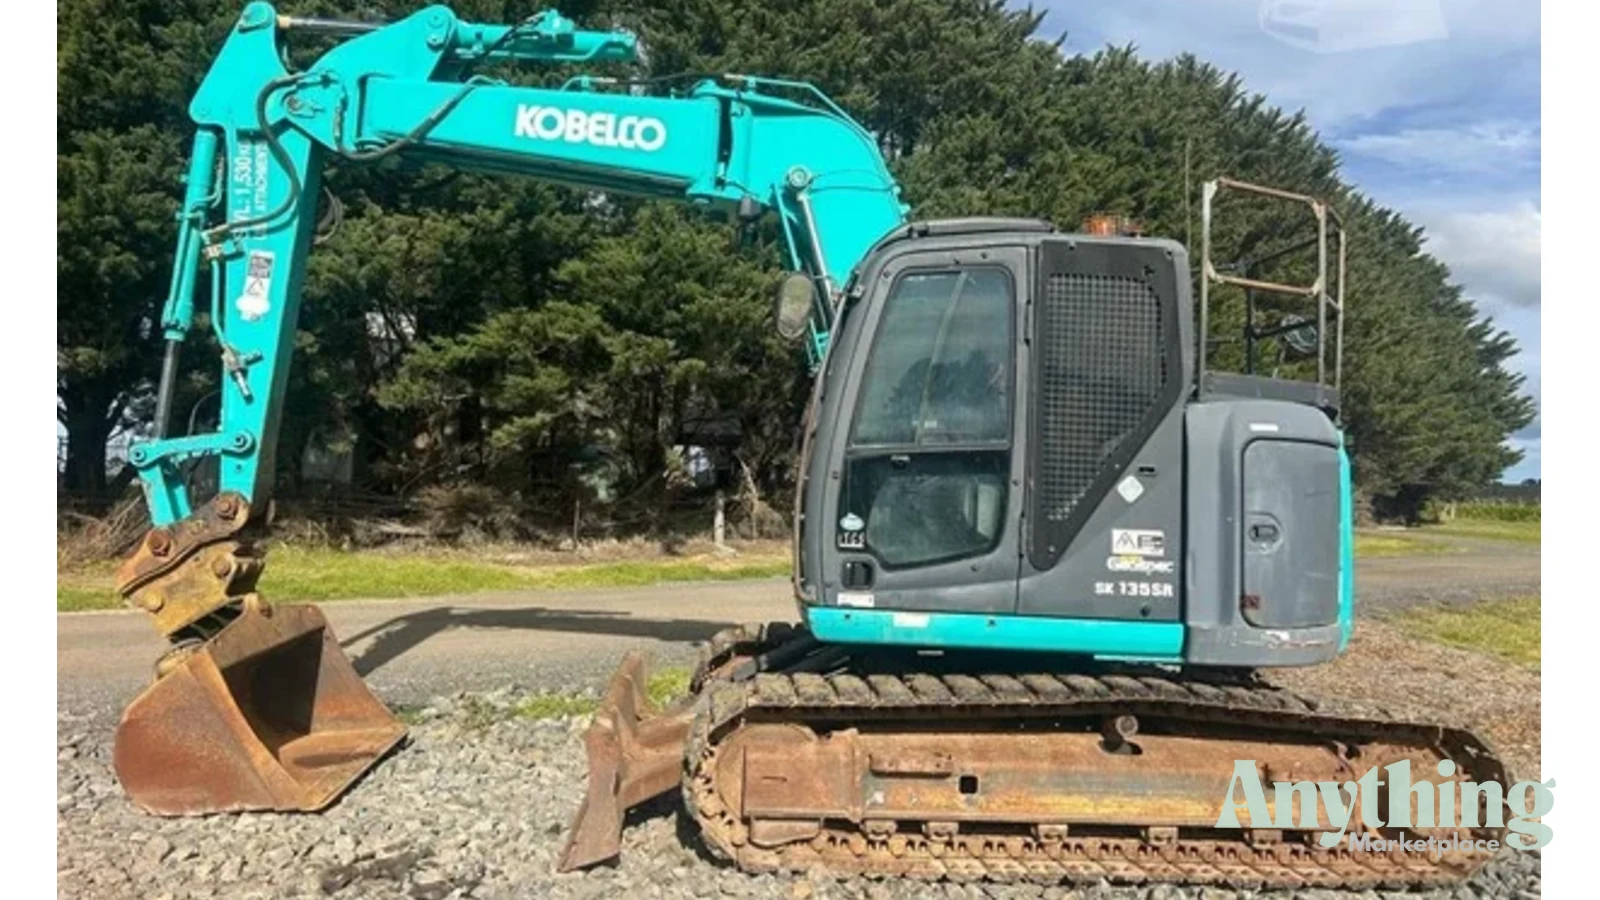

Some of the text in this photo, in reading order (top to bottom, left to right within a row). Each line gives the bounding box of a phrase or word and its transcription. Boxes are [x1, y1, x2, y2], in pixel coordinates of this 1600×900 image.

[514, 103, 667, 152] KOBELCO
[1094, 581, 1174, 597] SK 135SR
